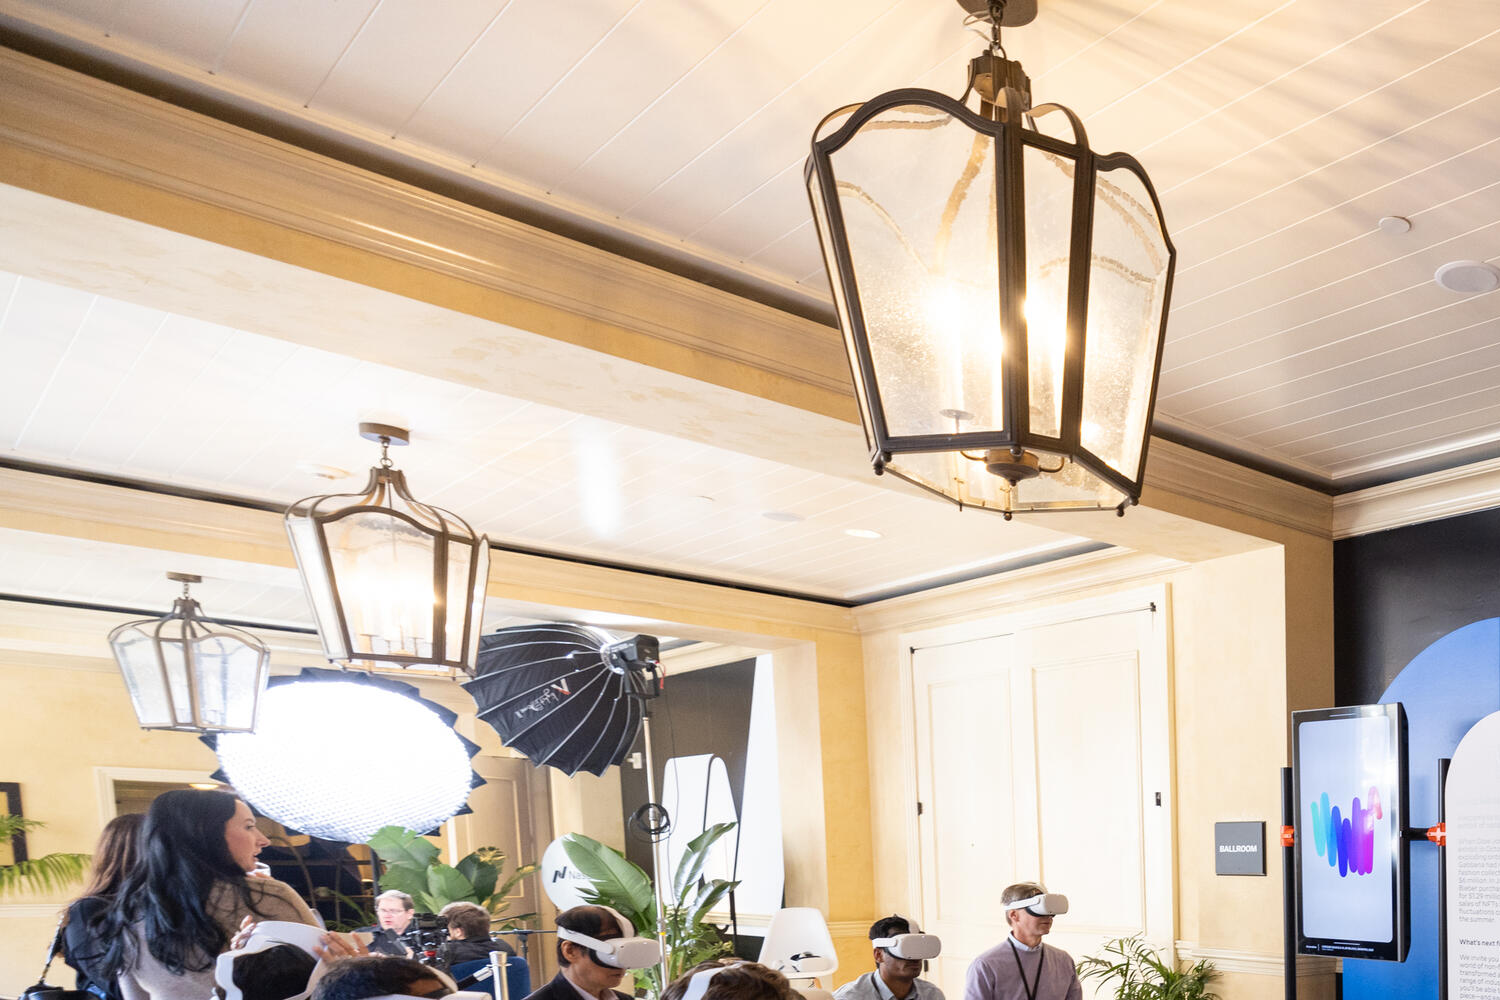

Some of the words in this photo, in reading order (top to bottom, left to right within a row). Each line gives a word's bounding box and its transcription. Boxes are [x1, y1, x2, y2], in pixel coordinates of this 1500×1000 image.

[1219, 844, 1258, 853] BALLROOM
[1459, 969, 1497, 978] transformed
[1459, 985, 1475, 994] you'll
